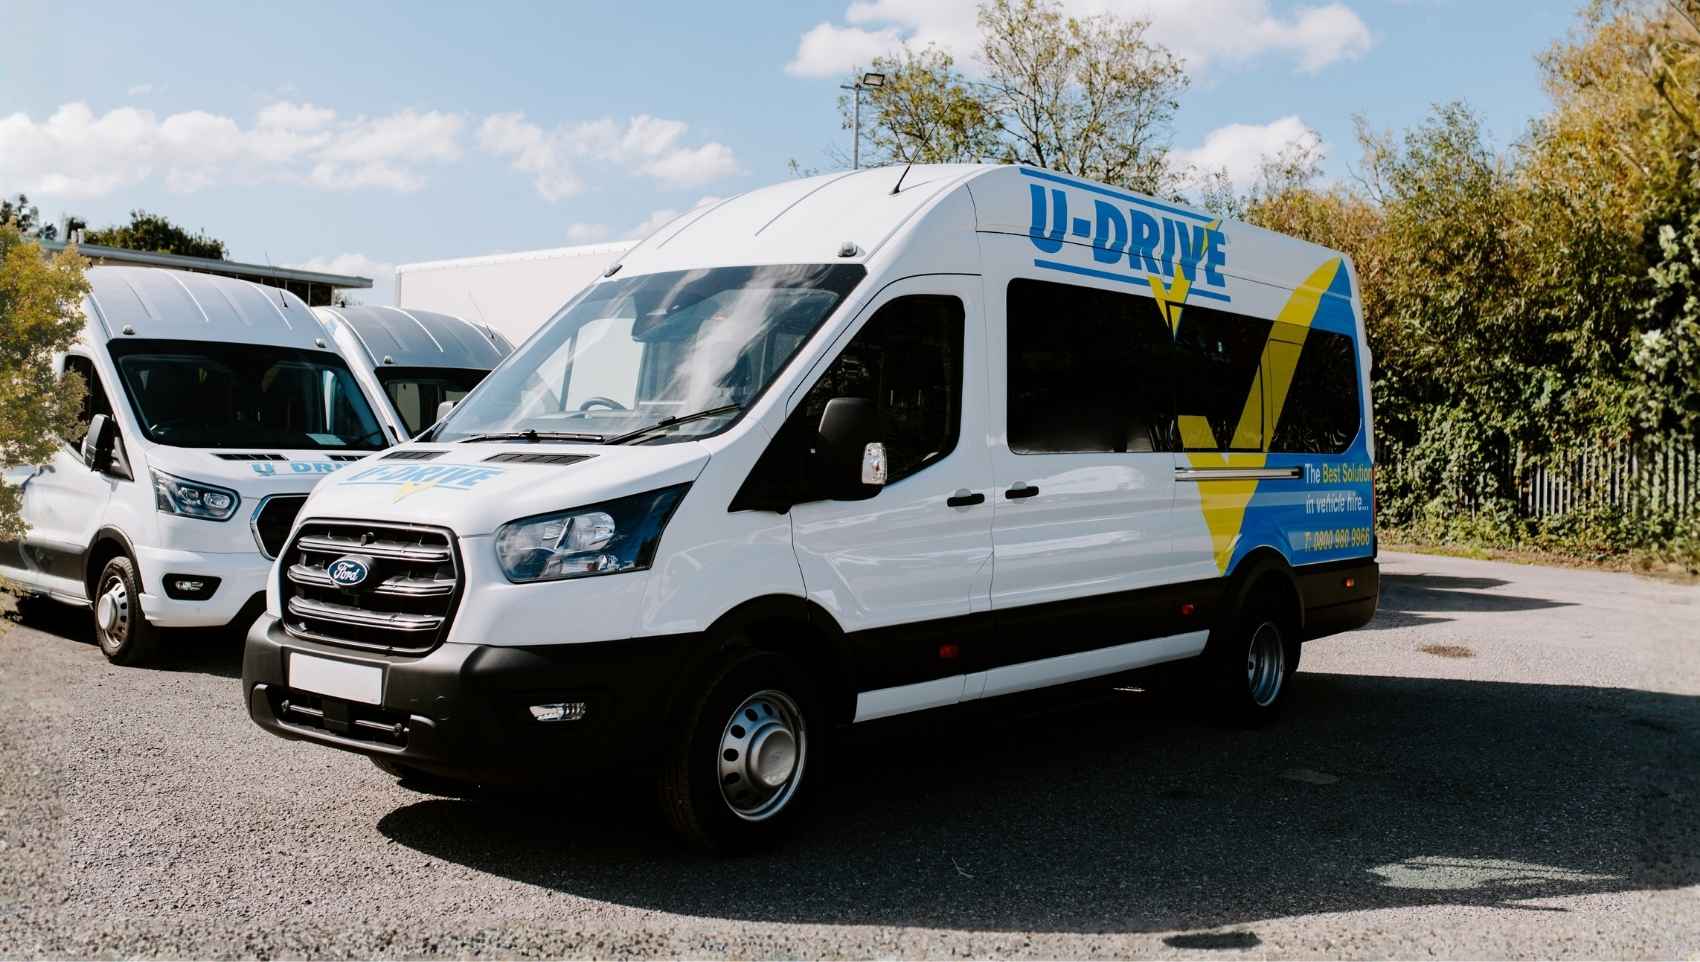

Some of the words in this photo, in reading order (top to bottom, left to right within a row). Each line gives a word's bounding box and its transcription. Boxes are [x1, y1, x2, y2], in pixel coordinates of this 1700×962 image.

[1030, 183, 1226, 288] U-DRIVE
[347, 465, 504, 487] U-DRIVE
[1304, 463, 1320, 484] The
[1322, 463, 1341, 483] Best
[1342, 463, 1372, 483] Solution
[1305, 493, 1315, 514] in
[1316, 492, 1345, 514] vehicle
[1314, 529, 1333, 552] 0800
[334, 562, 361, 581] Ford
